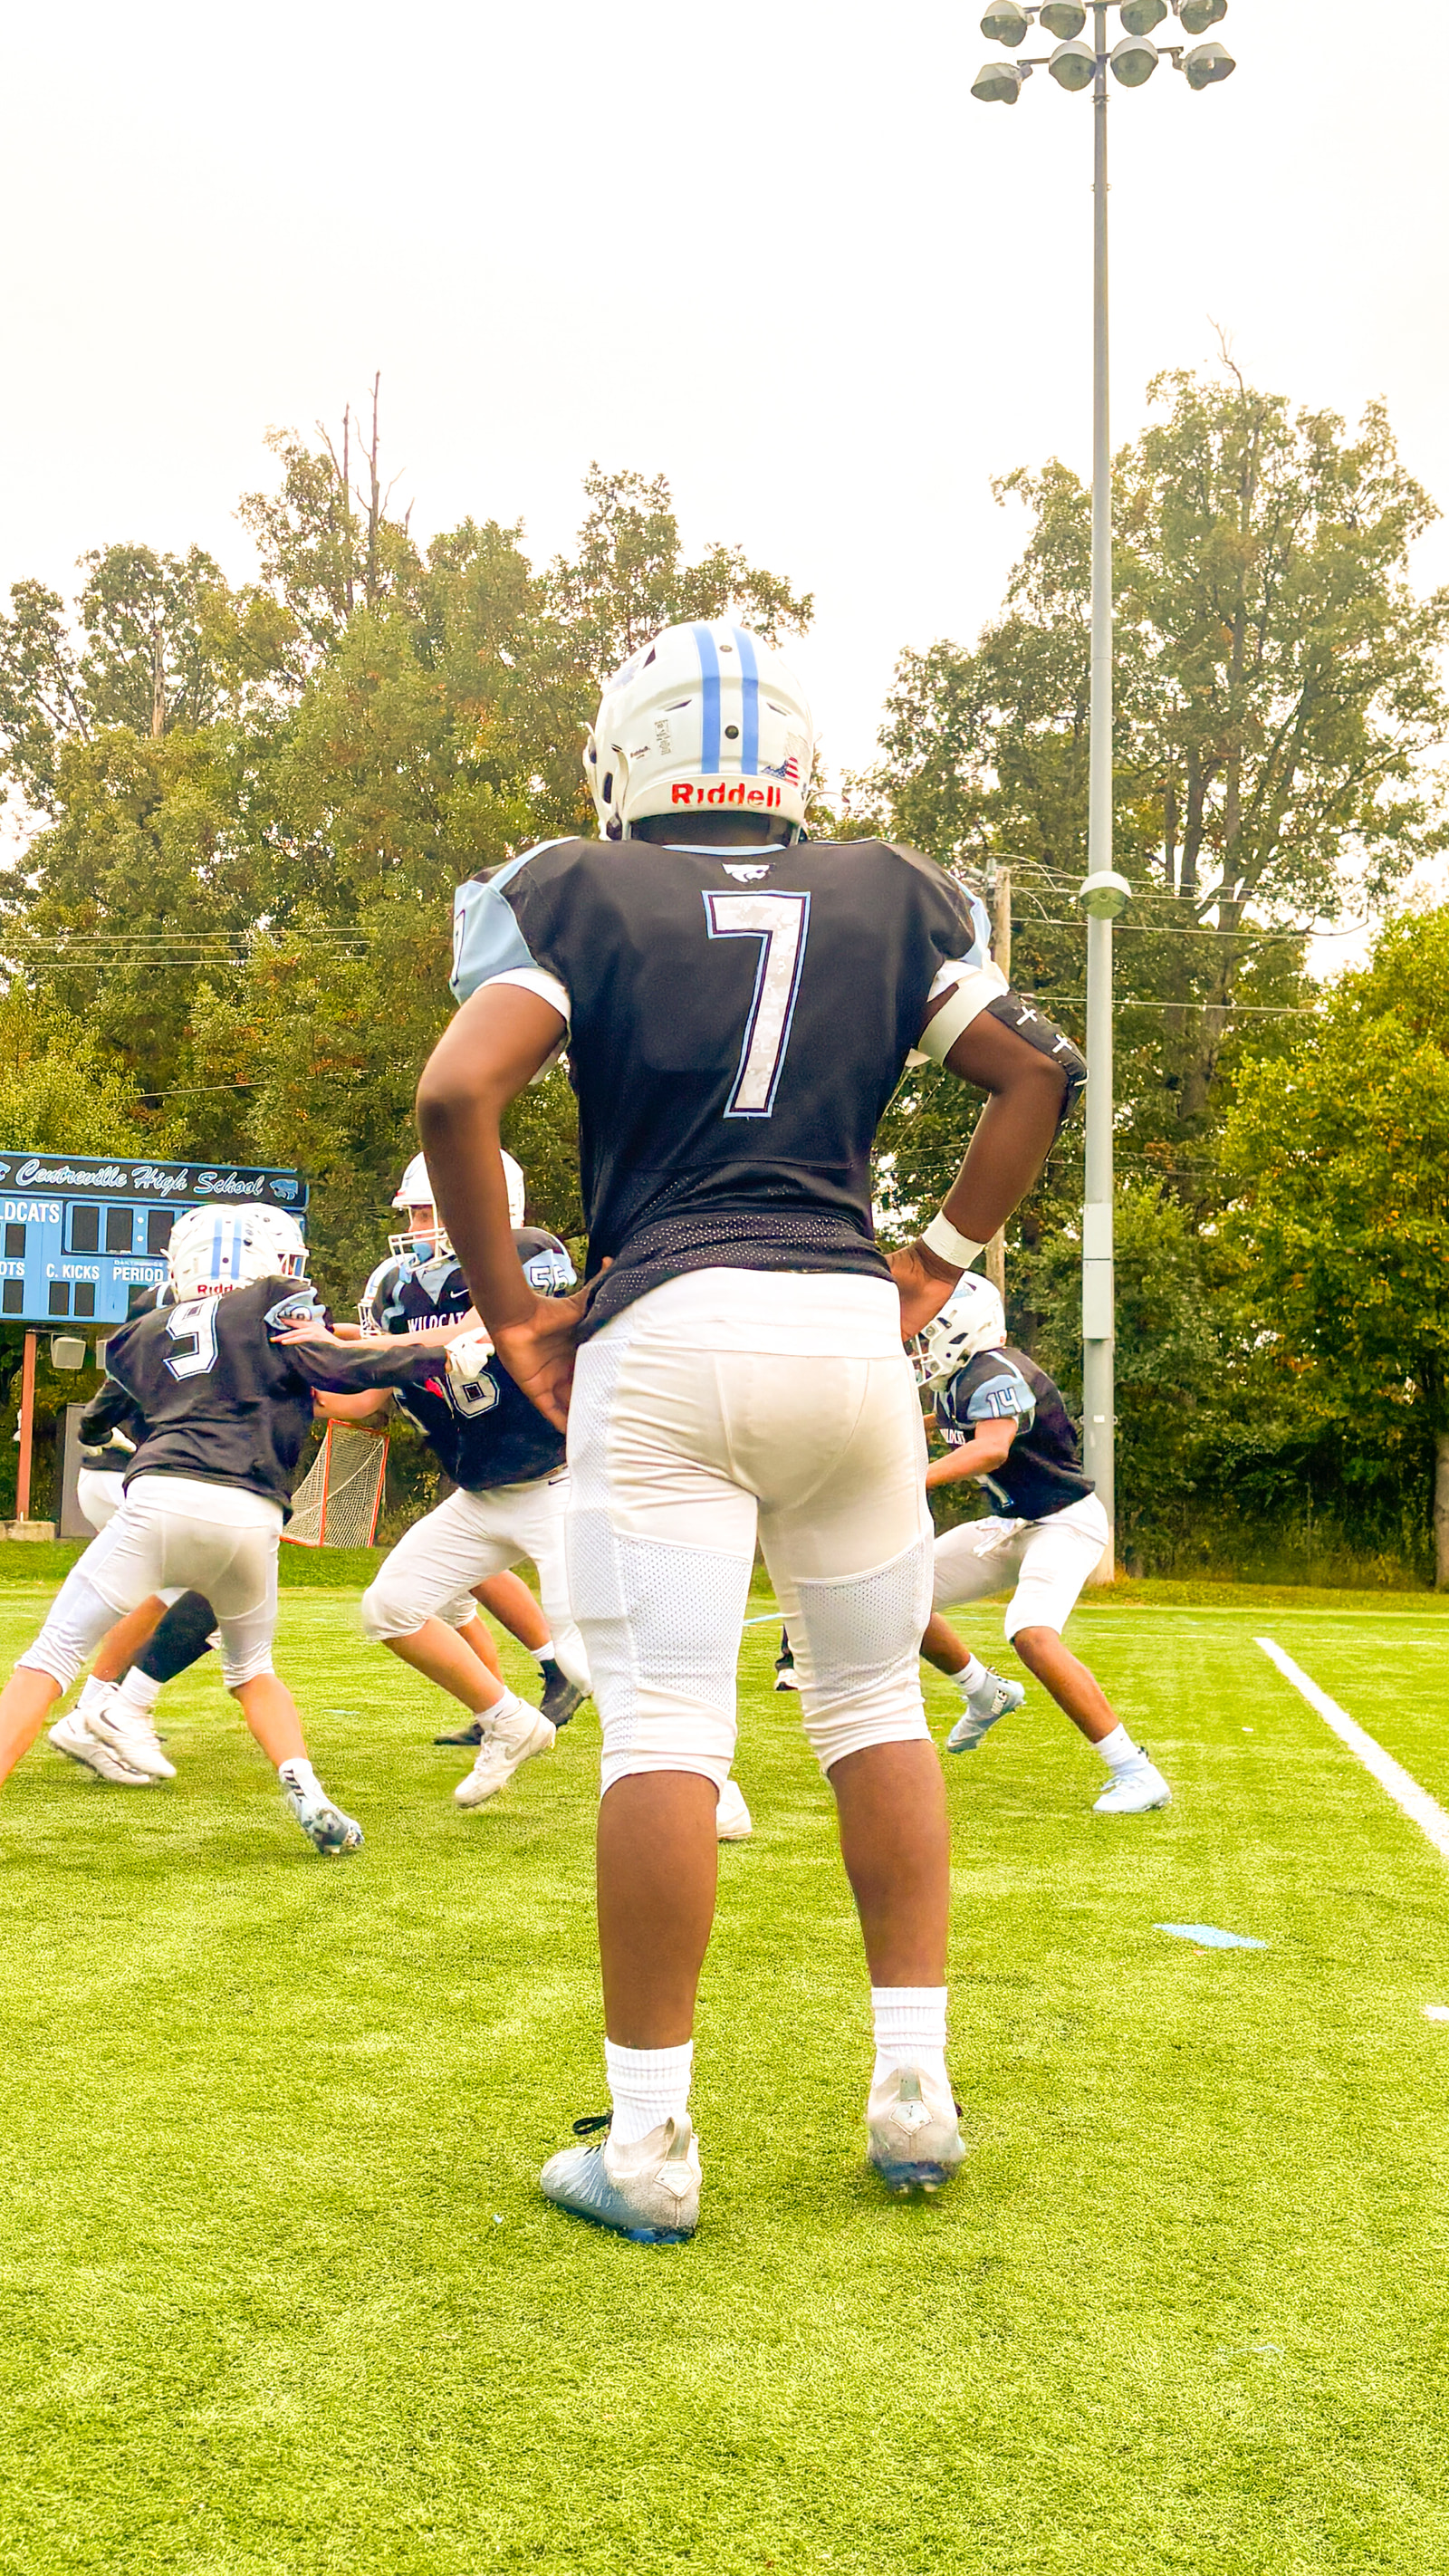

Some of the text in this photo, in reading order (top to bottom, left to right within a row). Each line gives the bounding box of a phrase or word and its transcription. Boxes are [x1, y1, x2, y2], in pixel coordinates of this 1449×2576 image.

[670, 782, 782, 809] Riddell
[701, 889, 811, 1119] 7
[15, 1158, 264, 1197] Centreville High School
[0, 1201, 60, 1224] DCATS
[46, 1264, 100, 1280] C. KICKS
[113, 1266, 164, 1282] PERIOD
[197, 1283, 234, 1295] Ridd
[408, 1311, 465, 1333] WILDCAT
[162, 1295, 223, 1381] 9
[985, 1386, 1022, 1418] 14
